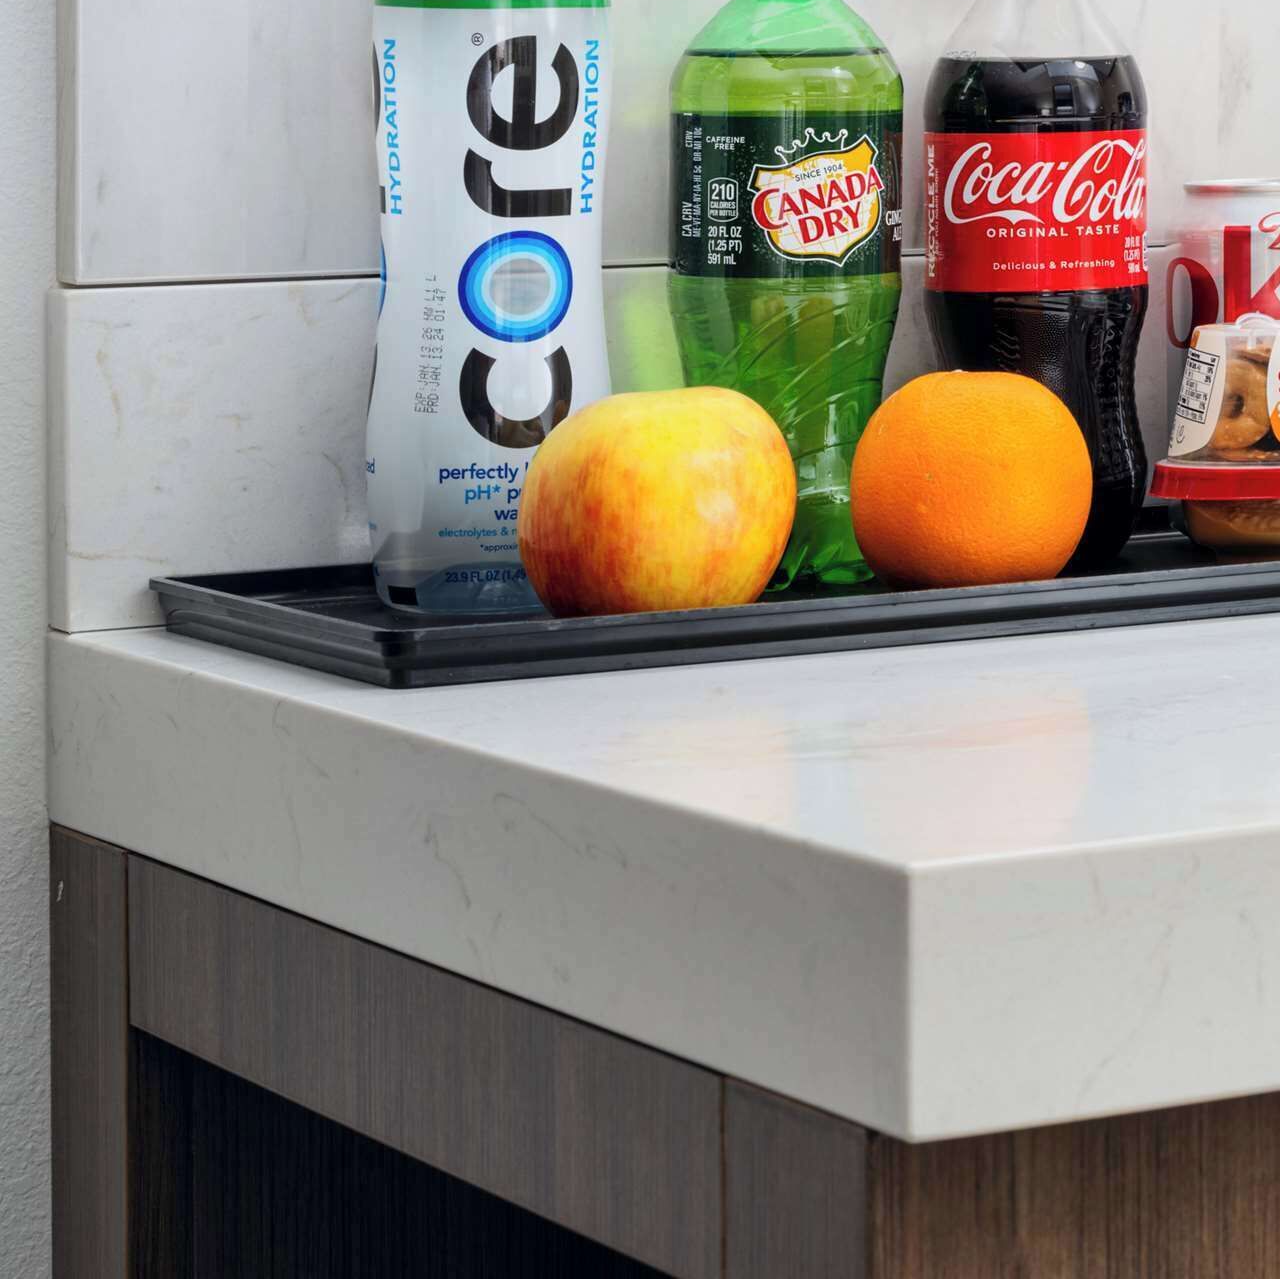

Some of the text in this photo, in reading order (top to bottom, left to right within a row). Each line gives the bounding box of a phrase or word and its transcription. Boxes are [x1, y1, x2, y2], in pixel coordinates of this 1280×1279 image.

[383, 39, 402, 215] HYDRATION
[580, 39, 599, 214] HYDRATION
[706, 135, 745, 144] CAFFEINE
[714, 143, 735, 151] FREE
[794, 163, 844, 183] SINCE 1904
[944, 138, 1147, 225] Coca-Cola
[711, 183, 735, 200] 210
[752, 166, 884, 232] CANADA
[710, 200, 736, 210] CALORIES
[927, 143, 936, 278] RECYCLE ME
[681, 200, 693, 237] CA CRV
[798, 201, 863, 244] DRY
[708, 226, 742, 237] 20 FL OZ
[986, 224, 1120, 239] ORIGINAL TASTE
[458, 34, 580, 449] core
[708, 239, 743, 254] (1.25 PT)
[707, 253, 737, 265] 591 mL
[993, 258, 1115, 271] Delicious & Refreshing
[438, 462, 519, 484] perfectly
[438, 526, 497, 539] electrolytes
[500, 526, 509, 537] &
